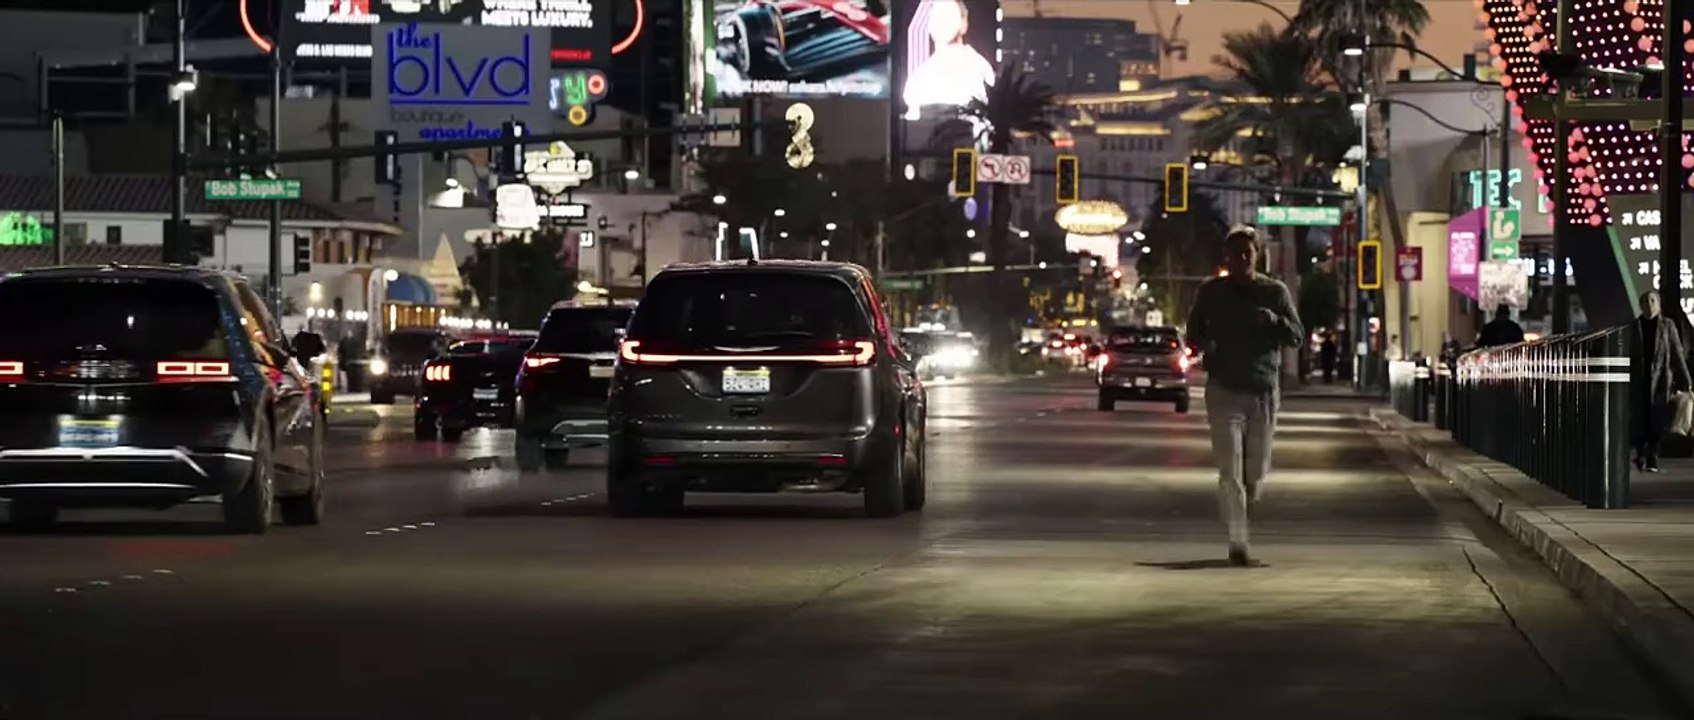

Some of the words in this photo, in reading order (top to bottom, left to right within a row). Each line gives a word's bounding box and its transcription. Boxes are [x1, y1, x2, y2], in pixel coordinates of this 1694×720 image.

[396, 22, 433, 48] the
[388, 32, 530, 97] blvd
[390, 108, 465, 126] boutique
[212, 180, 237, 197] Bob
[240, 180, 286, 199] Stupak
